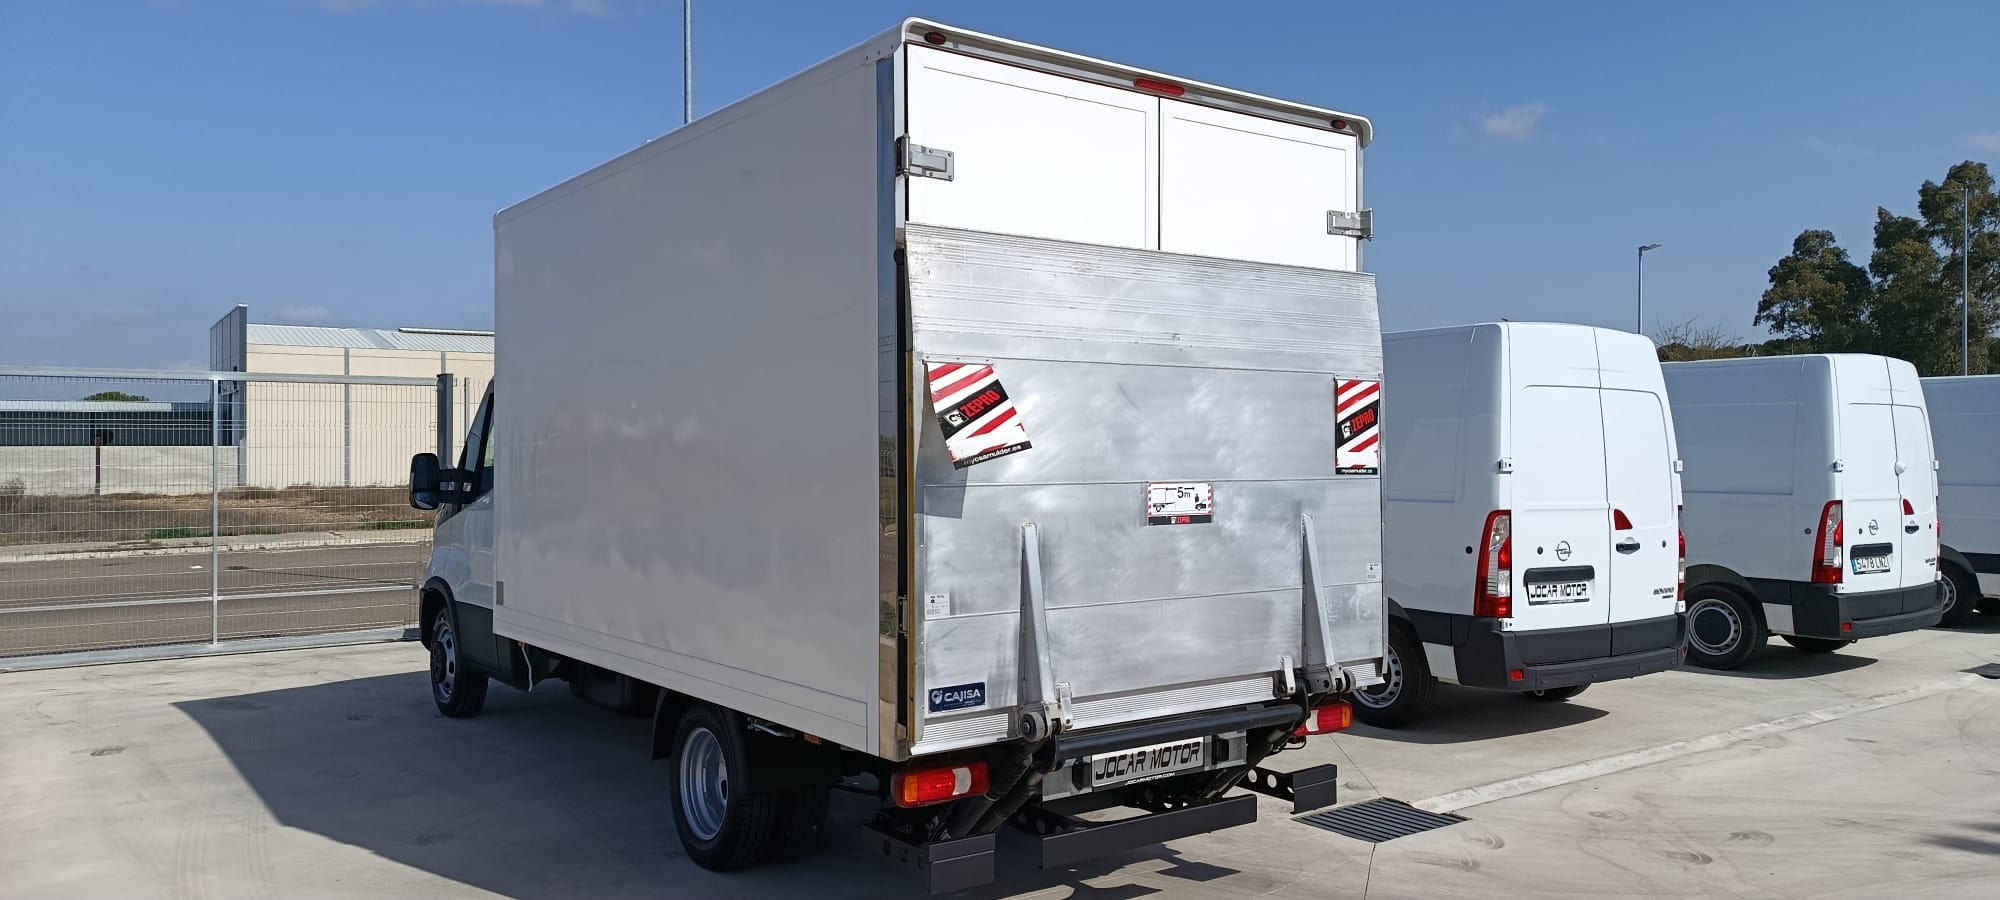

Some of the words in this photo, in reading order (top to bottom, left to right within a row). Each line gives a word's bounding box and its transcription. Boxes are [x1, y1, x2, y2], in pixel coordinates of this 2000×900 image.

[960, 389, 1001, 417] ZEPRO
[1352, 408, 1375, 432] ZEPRO
[1856, 557, 1874, 570] 5478
[1531, 584, 1557, 598] JOCAR
[1560, 583, 1586, 597] MOTOR
[944, 689, 980, 702] CAJISA
[1096, 751, 1146, 780] JOCAR
[1150, 741, 1200, 769] MOTOR
[1124, 772, 1175, 785] JOCARMOTOR.COM
